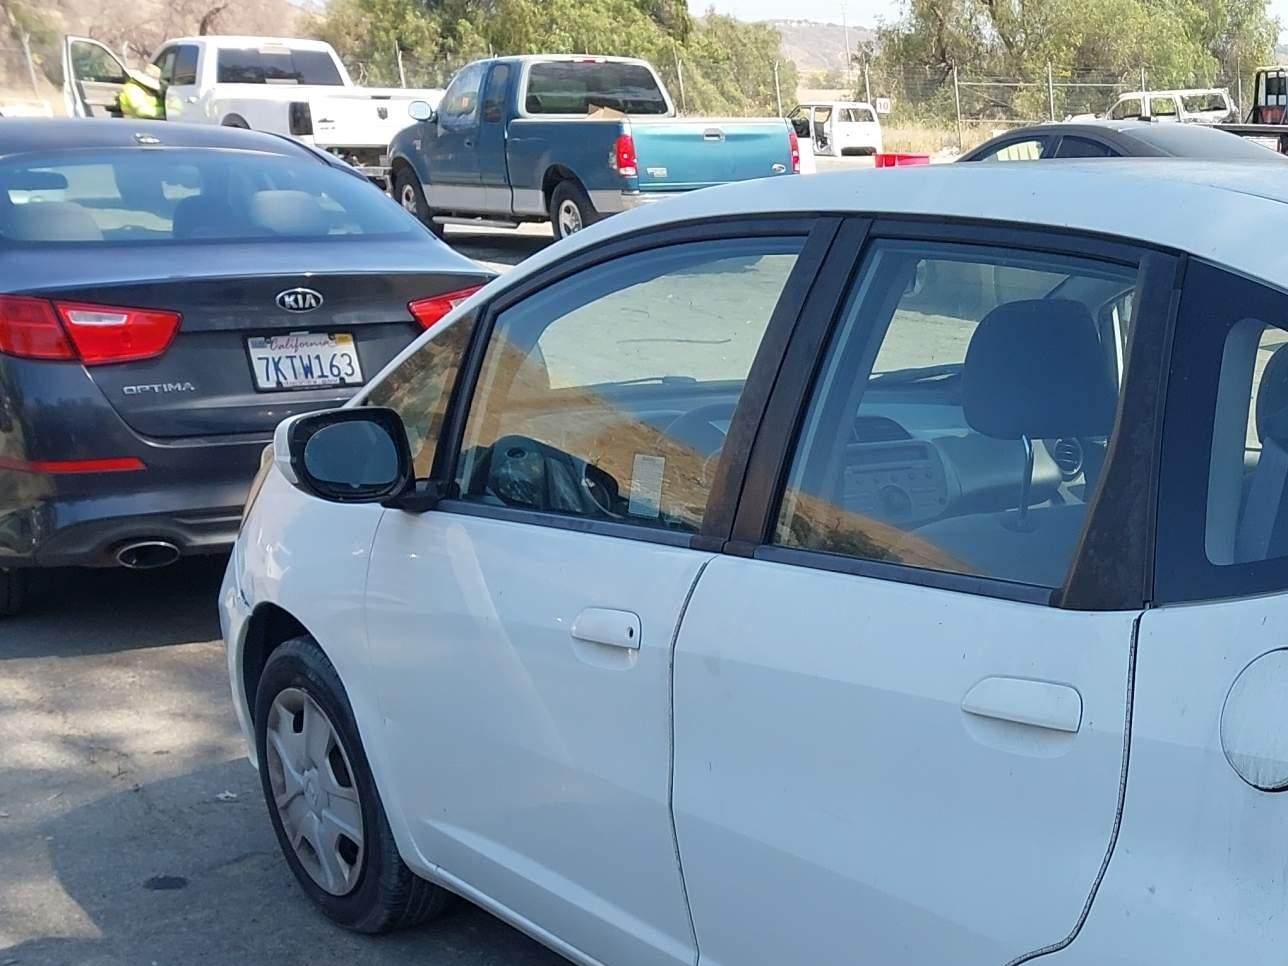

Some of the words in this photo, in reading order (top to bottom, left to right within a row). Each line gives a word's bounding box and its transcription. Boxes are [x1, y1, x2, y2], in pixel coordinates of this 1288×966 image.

[283, 294, 317, 308] KIA
[271, 336, 330, 352] California
[257, 352, 355, 382] 7KTW163
[123, 382, 196, 395] OPTIMA
